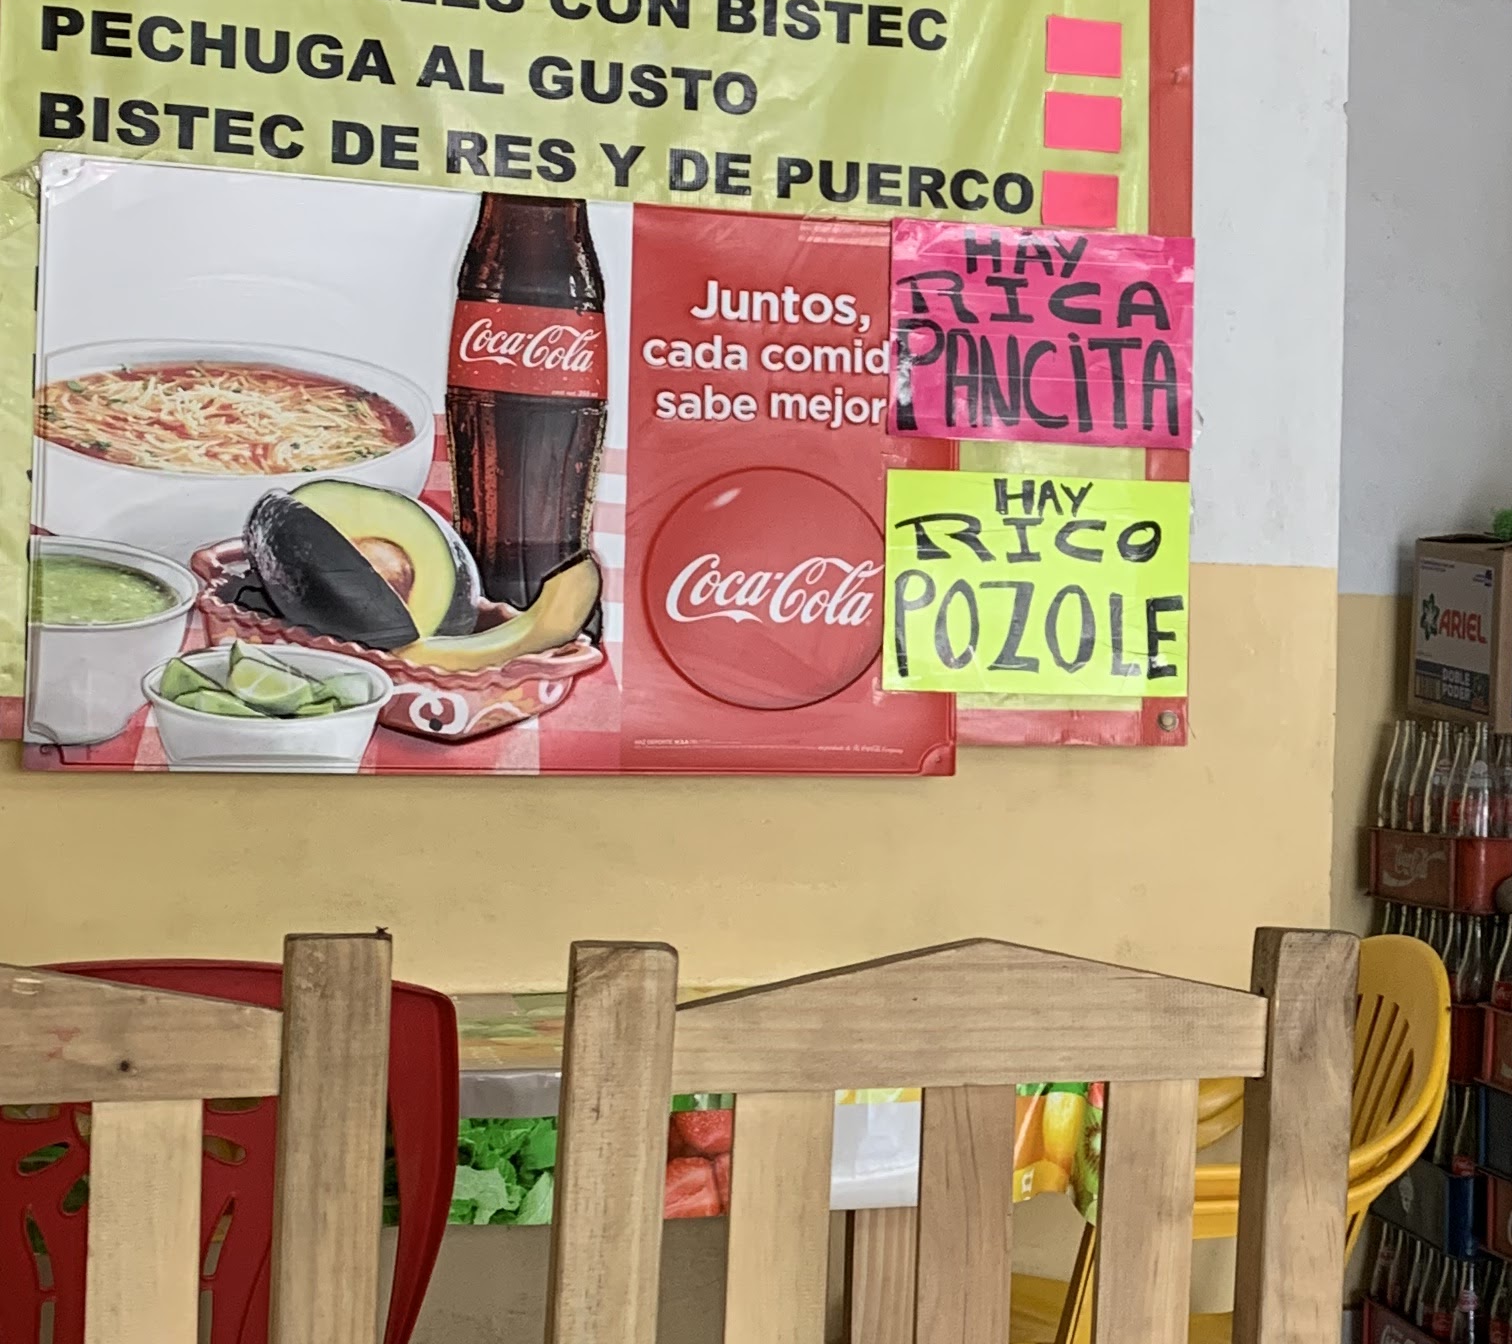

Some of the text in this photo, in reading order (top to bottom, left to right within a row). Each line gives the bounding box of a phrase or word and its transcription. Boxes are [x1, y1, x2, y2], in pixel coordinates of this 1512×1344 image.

[41, 5, 758, 115] PECHUGA AL GUSTO
[38, 91, 1034, 215] BISTEC DE RES Y DE PUERCO
[964, 229, 1089, 278] HAY
[690, 280, 872, 330] Juntos,
[896, 270, 1171, 329] RICA
[459, 316, 602, 376] Coca-Cola
[642, 334, 749, 372] cada
[655, 384, 757, 423] sabe
[896, 320, 1180, 437] PANCITA
[994, 478, 1094, 518] HAY
[894, 513, 1162, 564] RICO
[665, 553, 884, 629] Coca-Cola
[896, 567, 1185, 681] POZOLE
[1438, 609, 1488, 644] ARIEL
